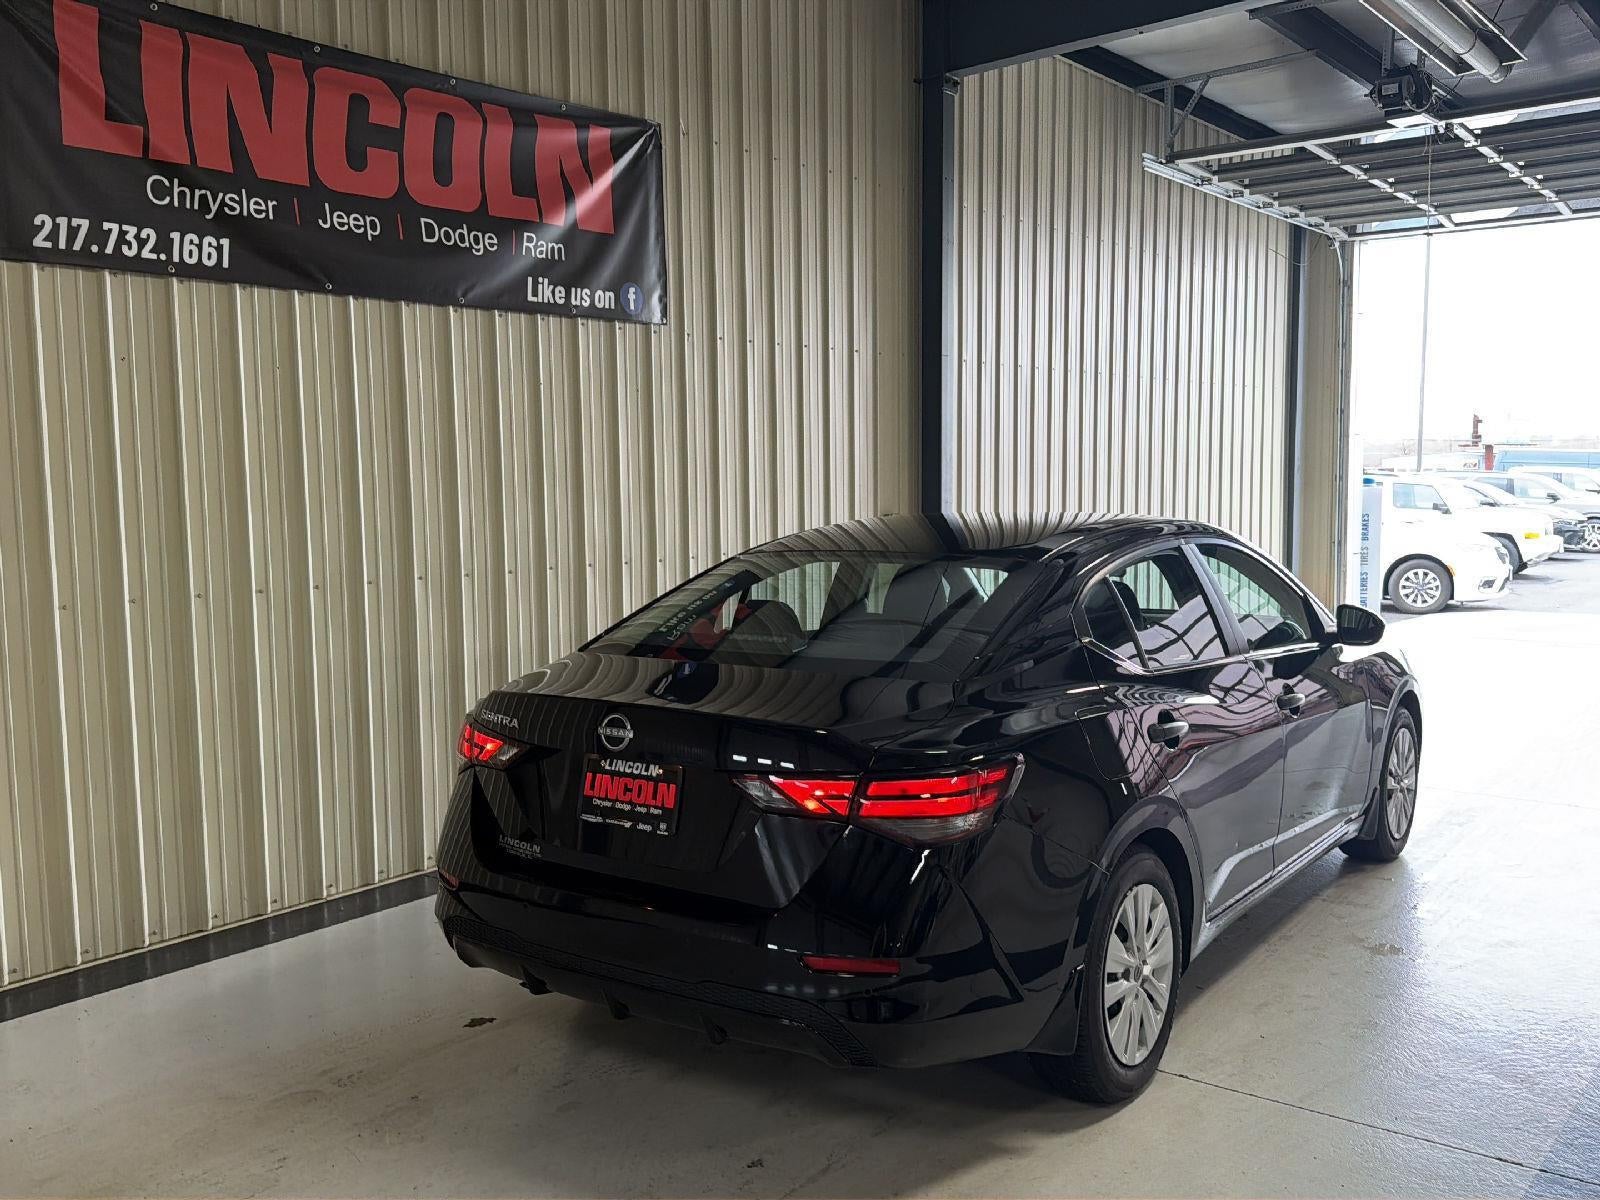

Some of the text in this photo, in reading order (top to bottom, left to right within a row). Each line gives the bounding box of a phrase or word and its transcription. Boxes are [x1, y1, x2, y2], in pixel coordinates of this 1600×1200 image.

[53, 0, 616, 235] LINCOLN
[145, 174, 566, 262] Chrysler Jeep Dodge Ram
[32, 213, 230, 269] 217.732.1661
[526, 275, 566, 306] Like
[570, 286, 591, 308] us
[594, 288, 616, 310] on
[1360, 513, 1370, 541] BRAKES
[1360, 546, 1369, 566] TIRES
[480, 708, 520, 729] SENTRA
[597, 726, 633, 739] NISSAN
[604, 758, 659, 777] LINCOLN
[583, 772, 677, 809] LINCOLN
[636, 822, 653, 833] Jeep
[499, 833, 542, 854] LINCOLN
